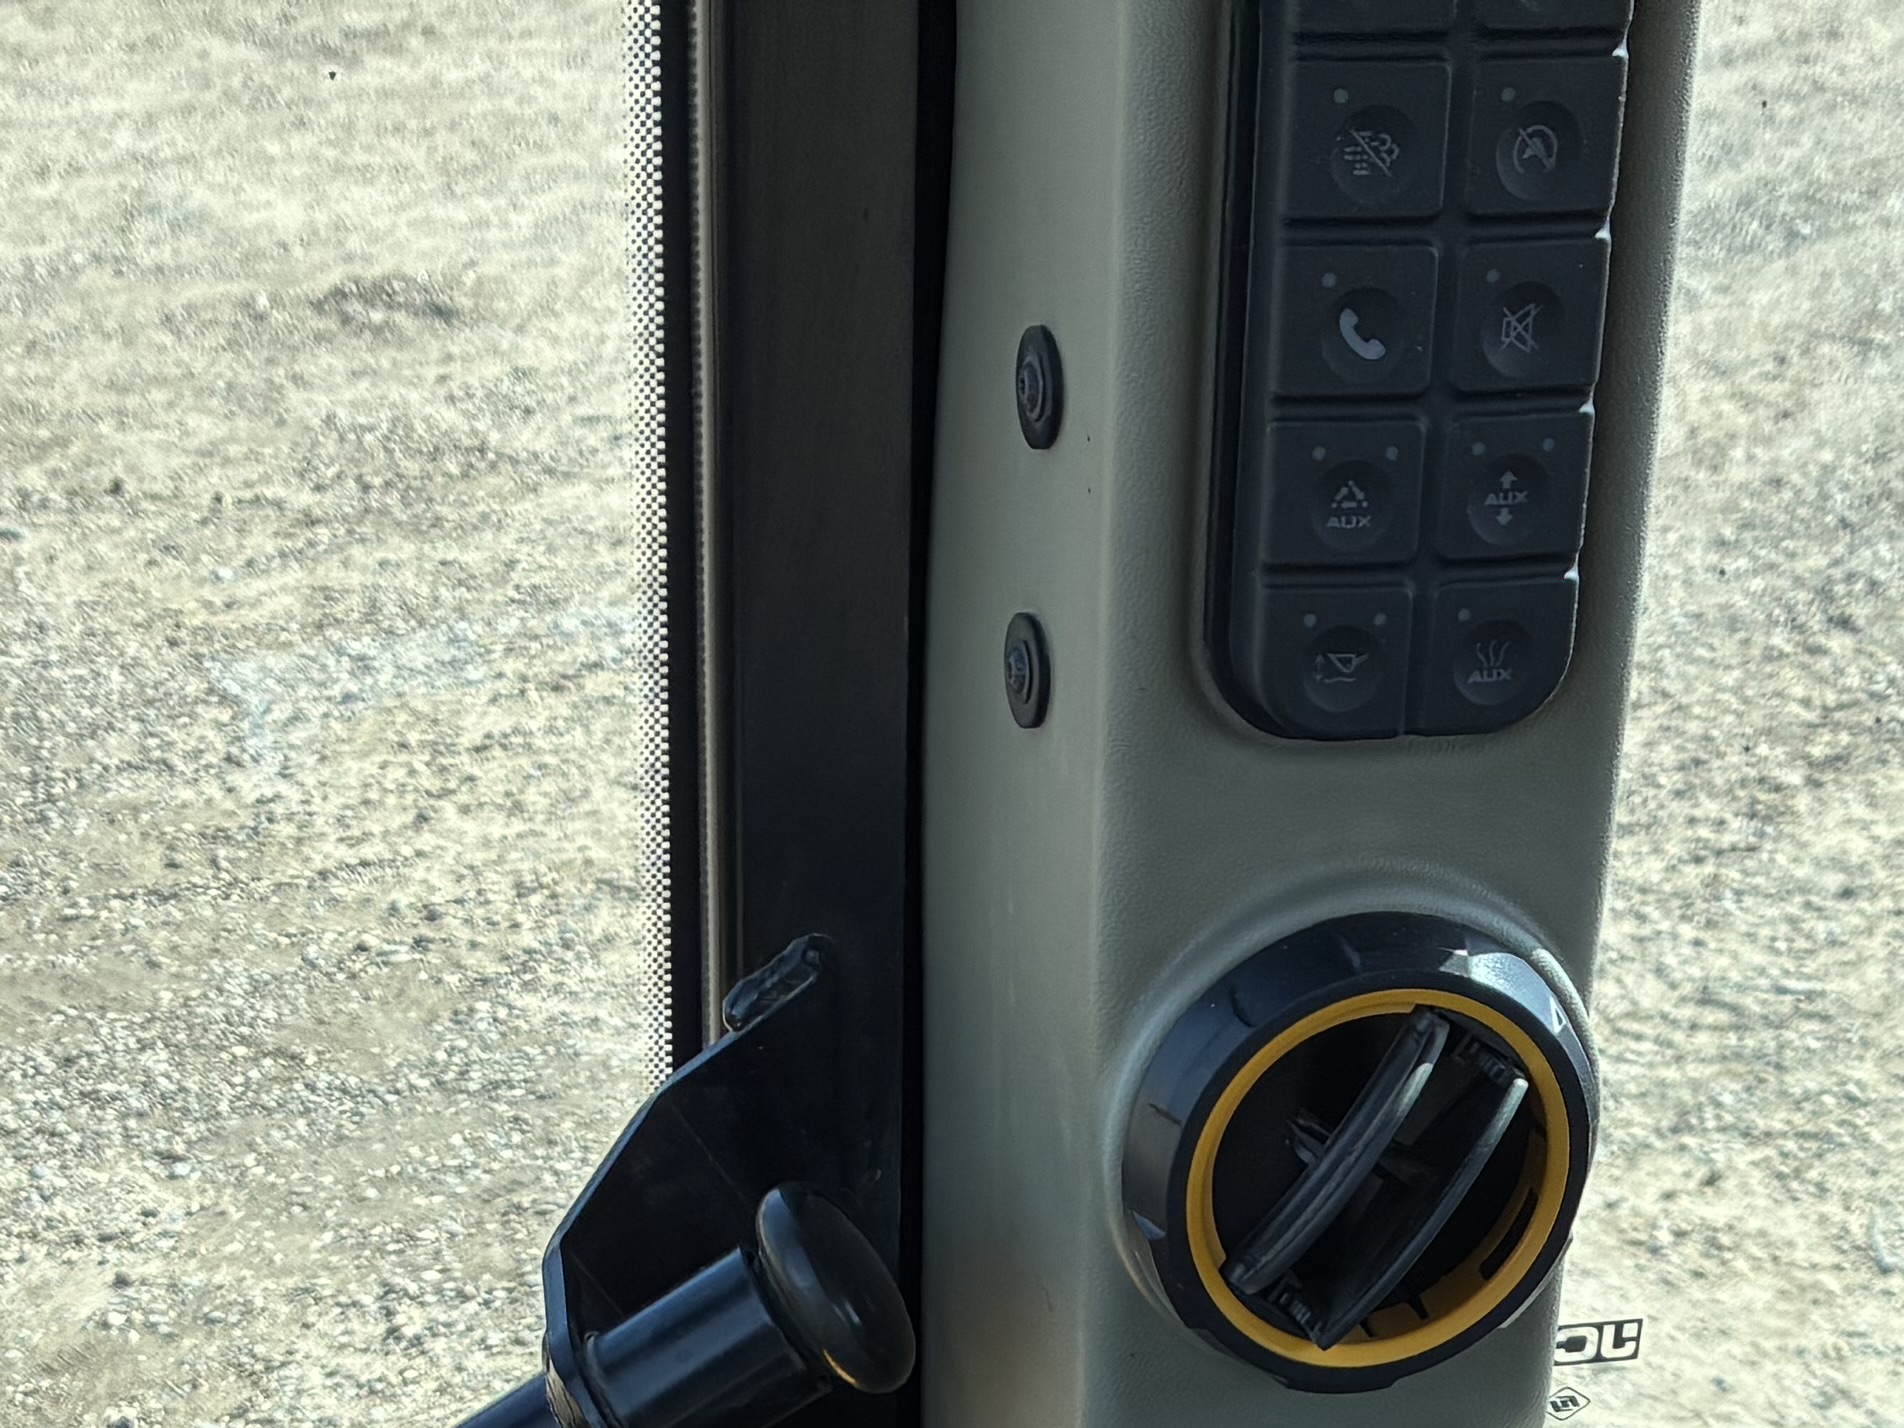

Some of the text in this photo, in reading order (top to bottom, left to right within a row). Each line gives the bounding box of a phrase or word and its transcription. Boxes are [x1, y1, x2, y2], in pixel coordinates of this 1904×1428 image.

[1485, 491, 1528, 505] AUX
[1326, 516, 1371, 528] AUX
[1468, 669, 1512, 682] AUX
